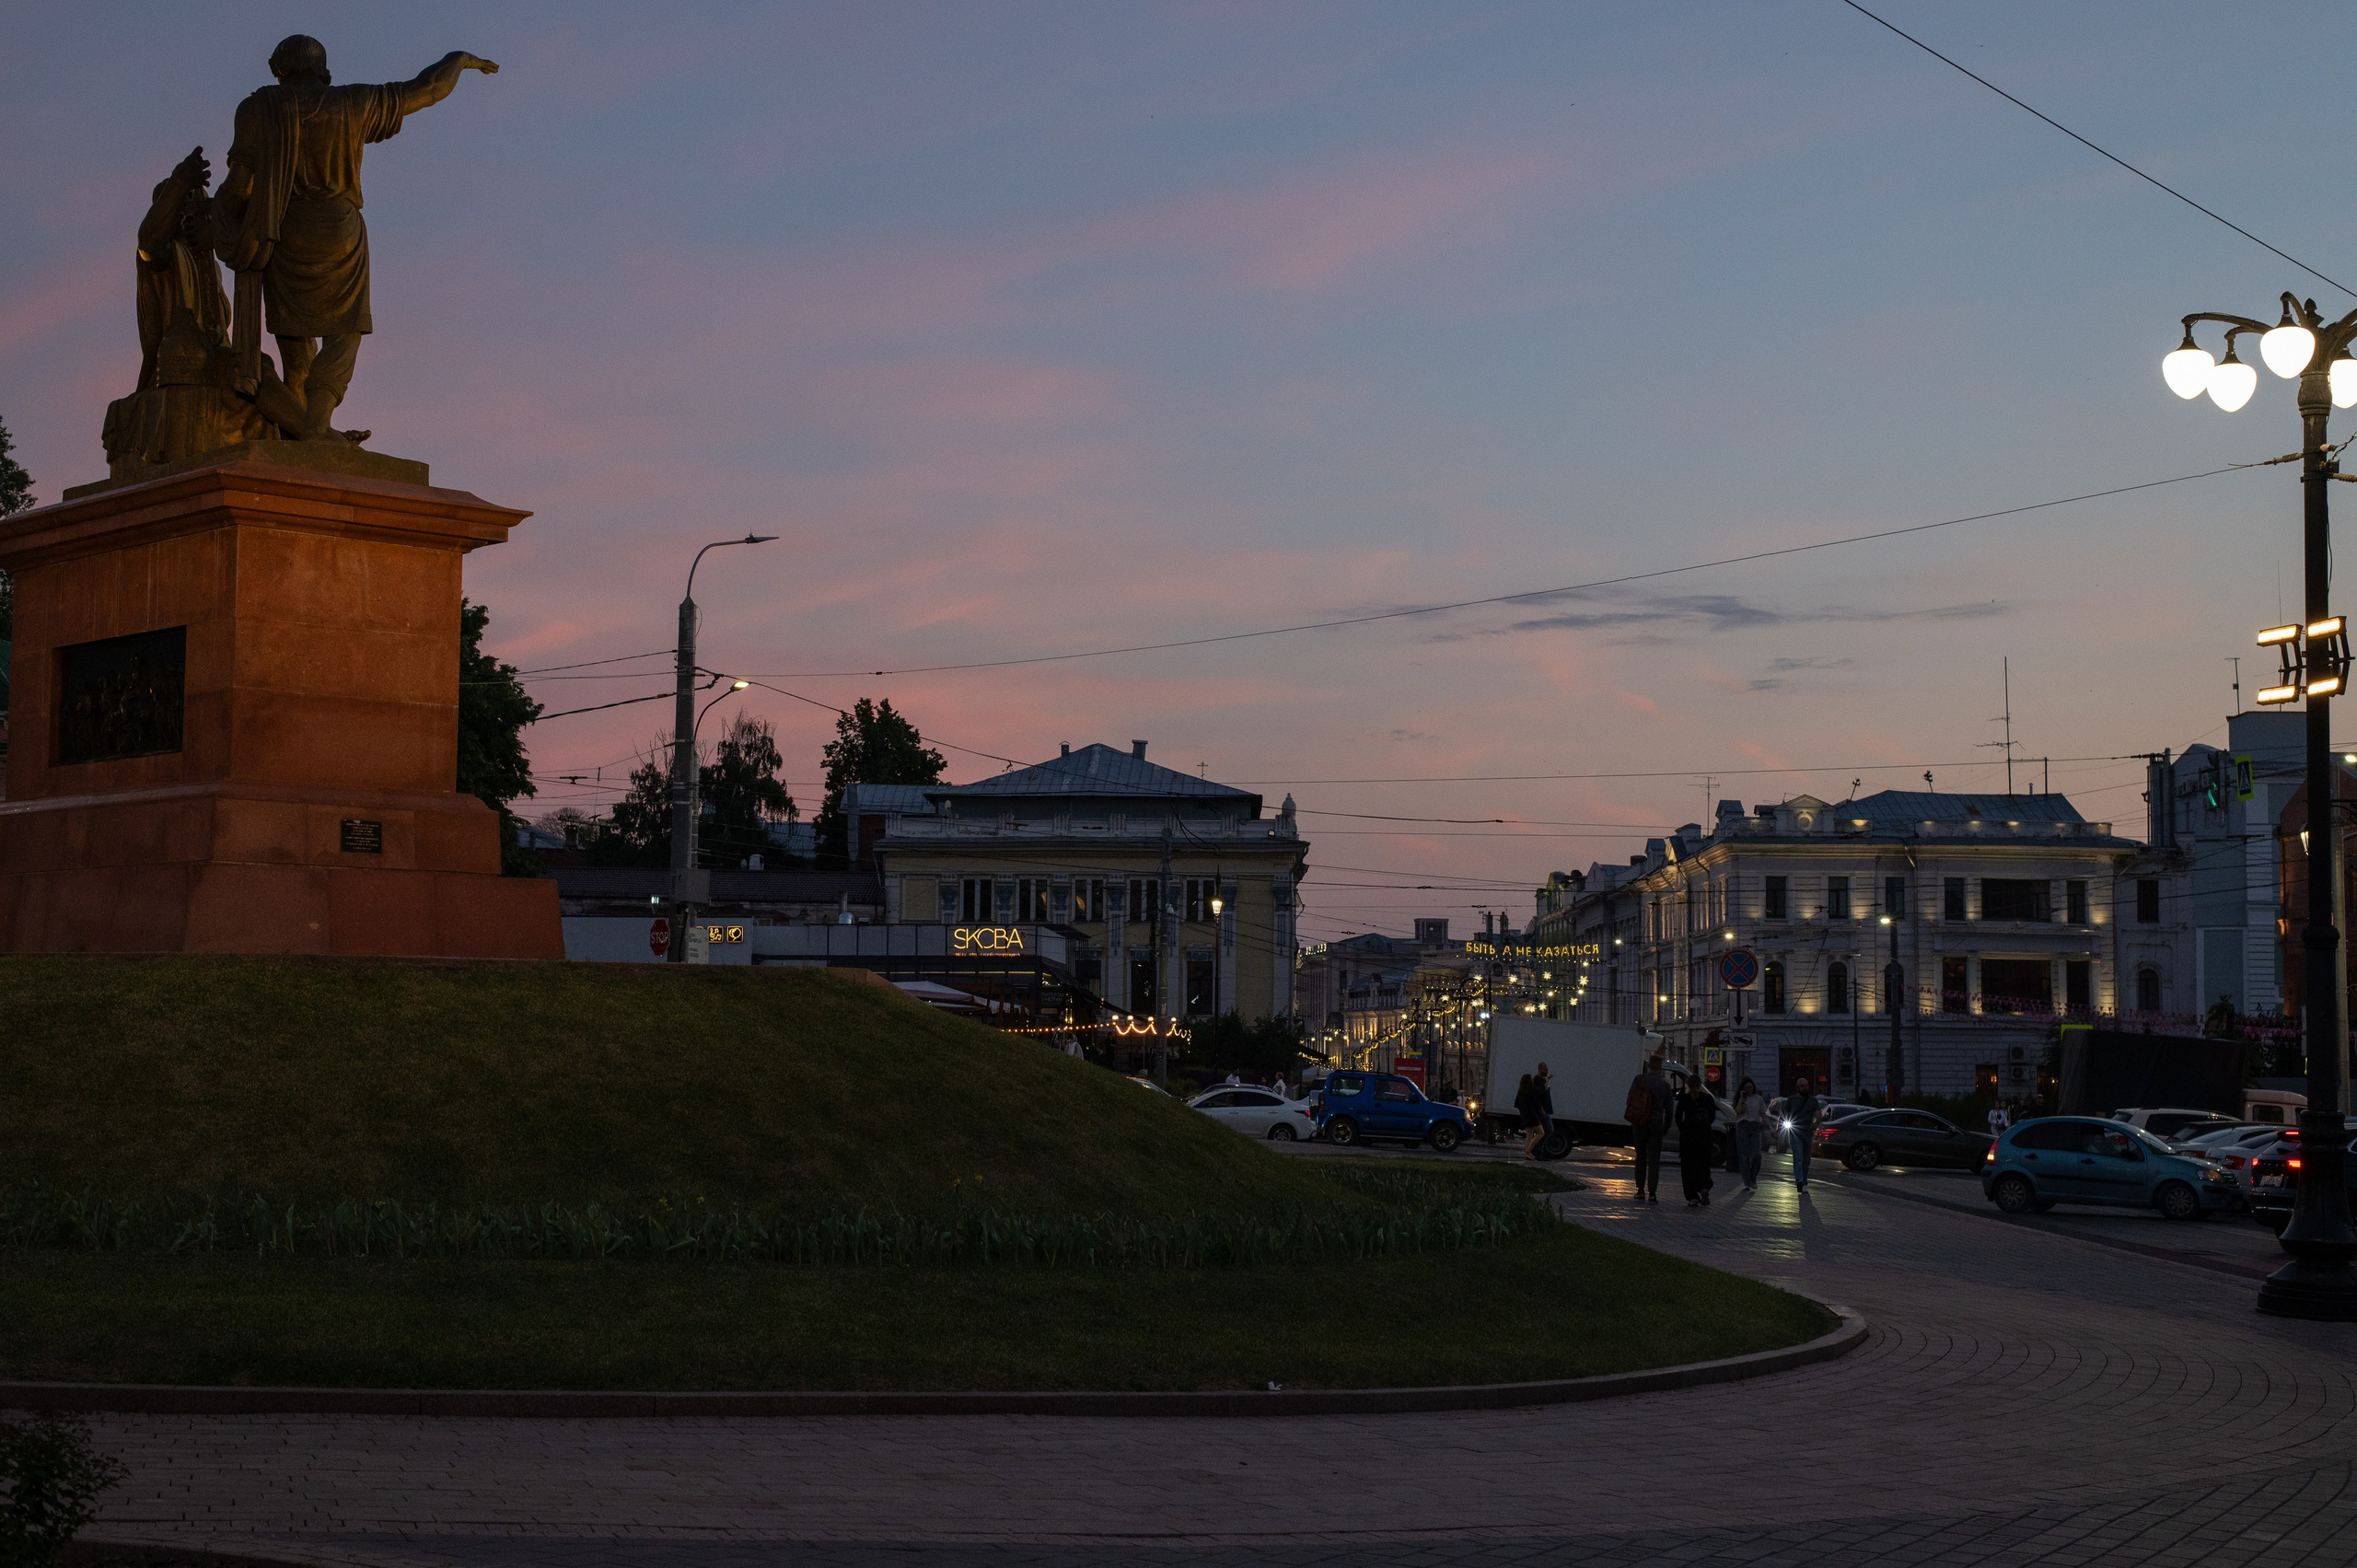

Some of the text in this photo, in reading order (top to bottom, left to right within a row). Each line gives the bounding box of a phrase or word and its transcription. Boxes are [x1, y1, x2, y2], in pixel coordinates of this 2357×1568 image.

[651, 931, 668, 945] STOP
[1503, 946, 1512, 956] А
[1515, 946, 1533, 957] НЕ
[1536, 944, 1599, 957] КАЗАТЬСЯ
